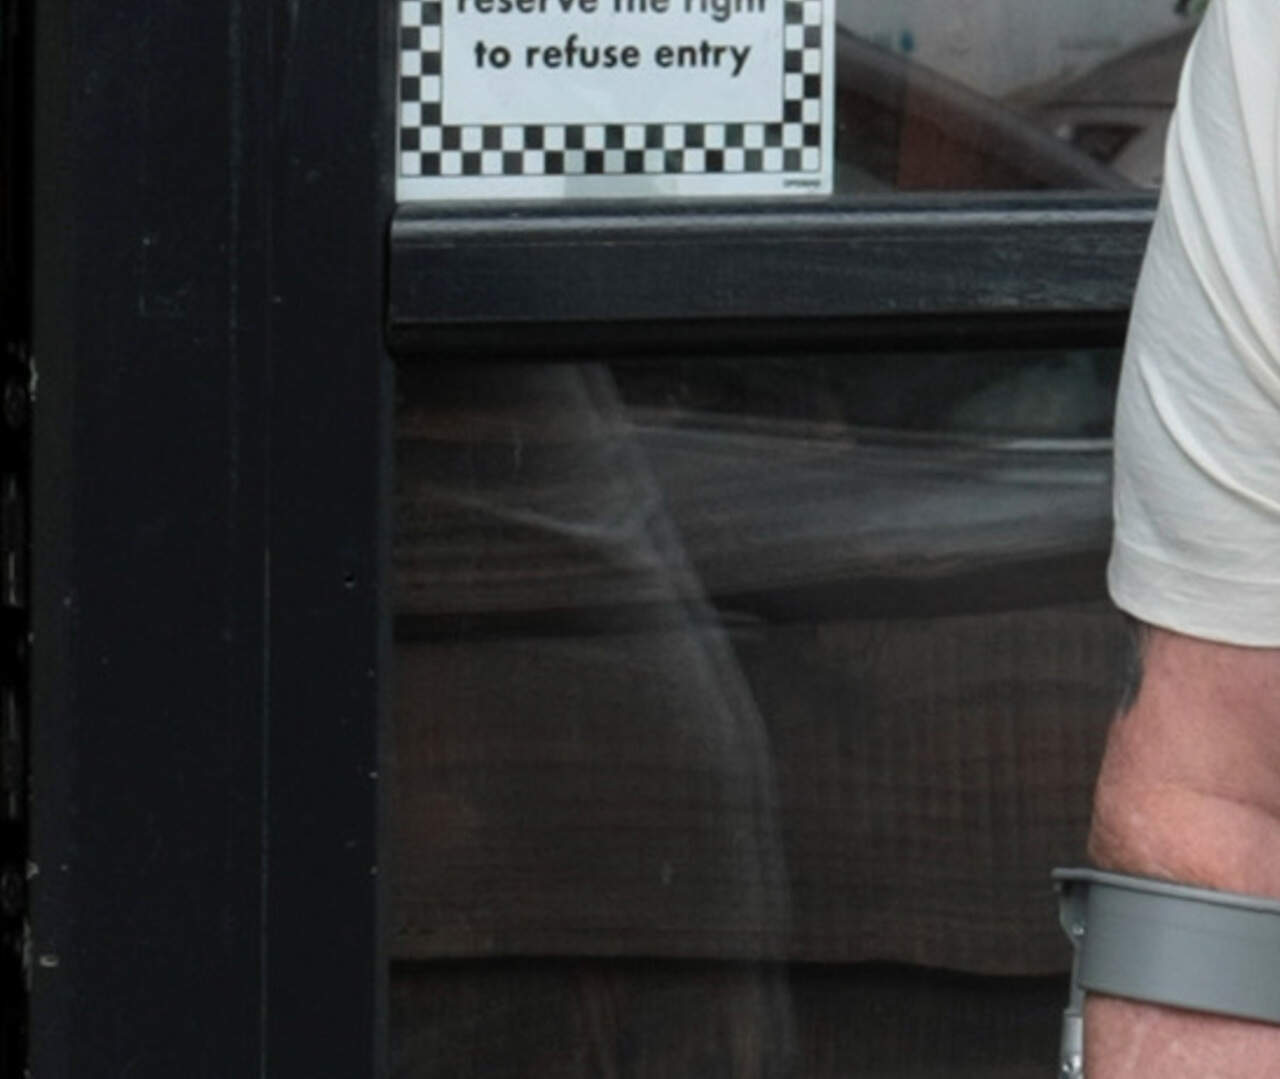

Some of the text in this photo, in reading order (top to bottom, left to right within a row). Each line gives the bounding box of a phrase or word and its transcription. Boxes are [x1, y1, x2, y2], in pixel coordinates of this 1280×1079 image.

[473, 34, 752, 78] to refuse entry
